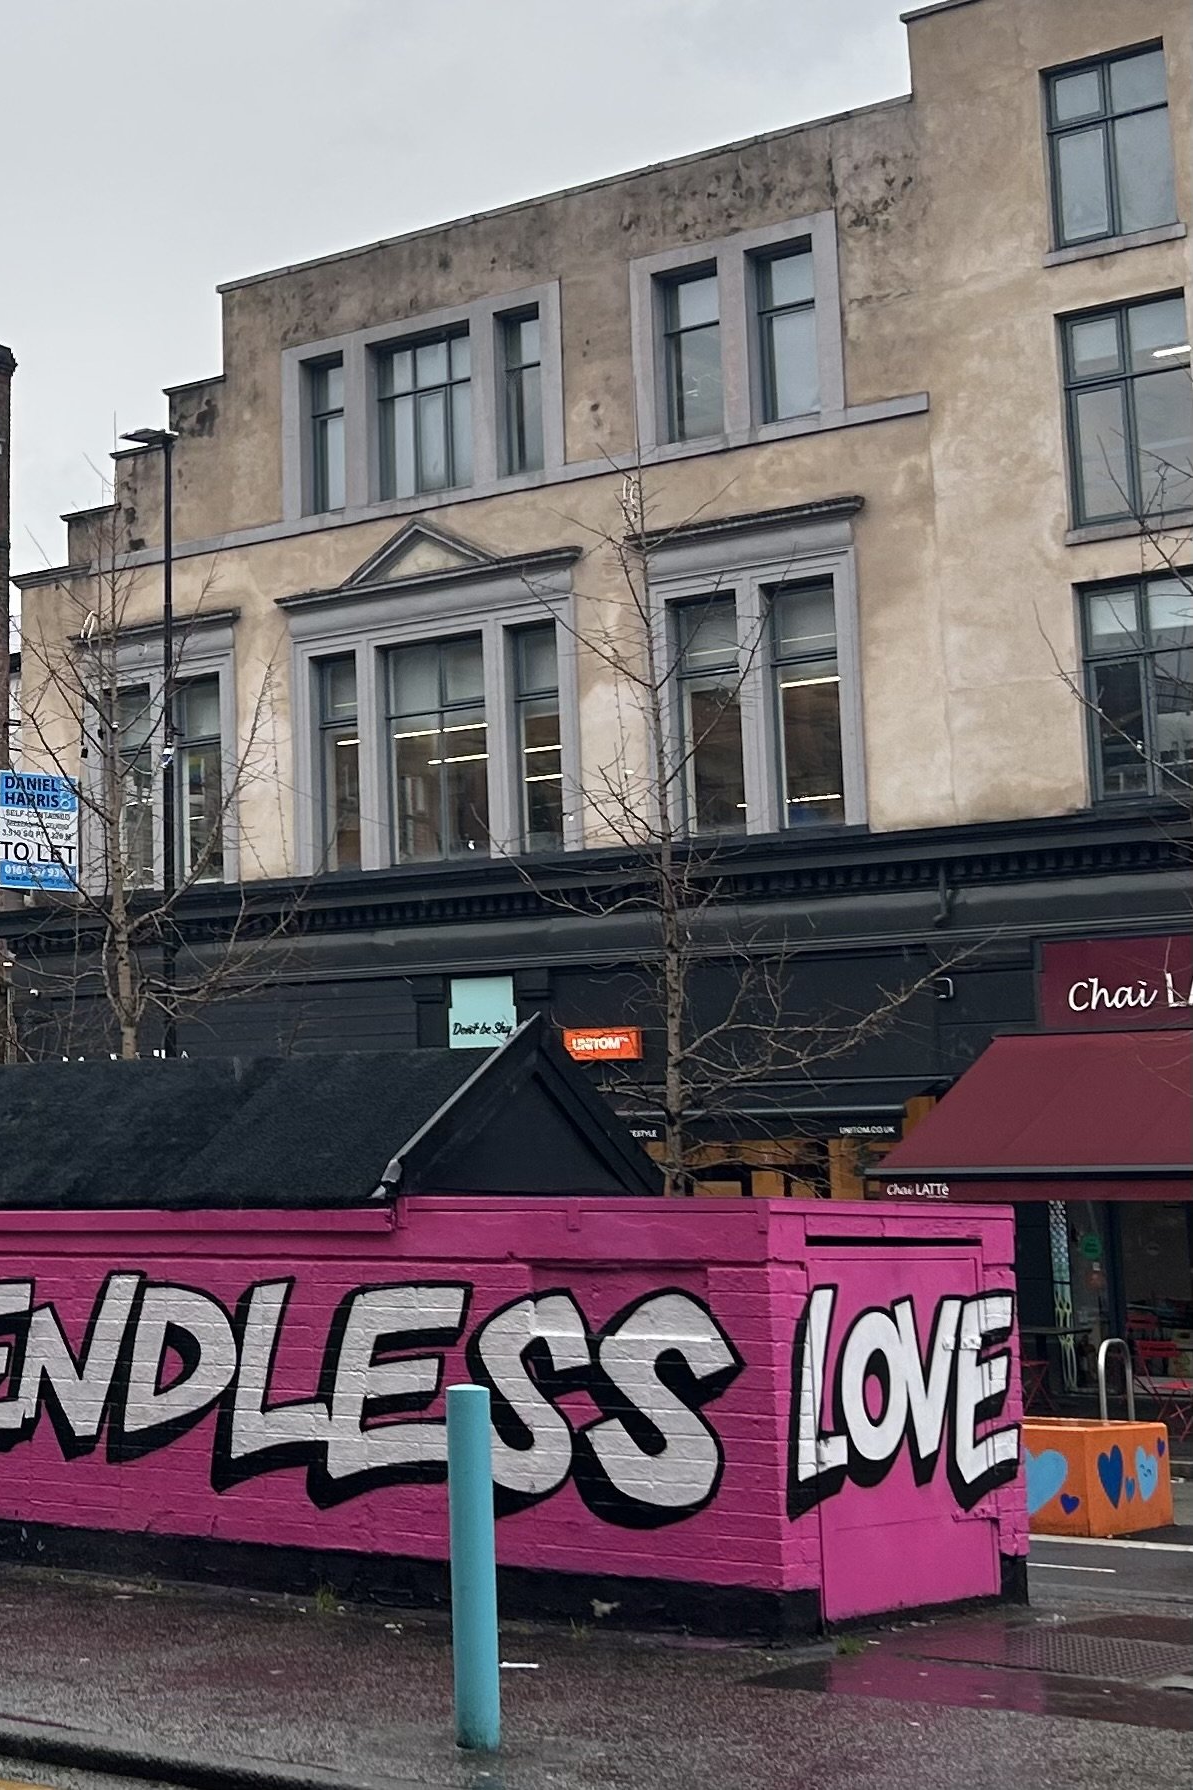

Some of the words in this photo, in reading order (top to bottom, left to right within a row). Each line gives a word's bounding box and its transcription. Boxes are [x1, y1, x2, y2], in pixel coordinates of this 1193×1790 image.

[5, 775, 58, 792] DANIEL
[5, 792, 59, 808] HARRIS
[0, 841, 29, 861] TO
[37, 844, 76, 864] LET
[1068, 977, 1158, 1011] Chai
[786, 1283, 1022, 1522] LOVE
